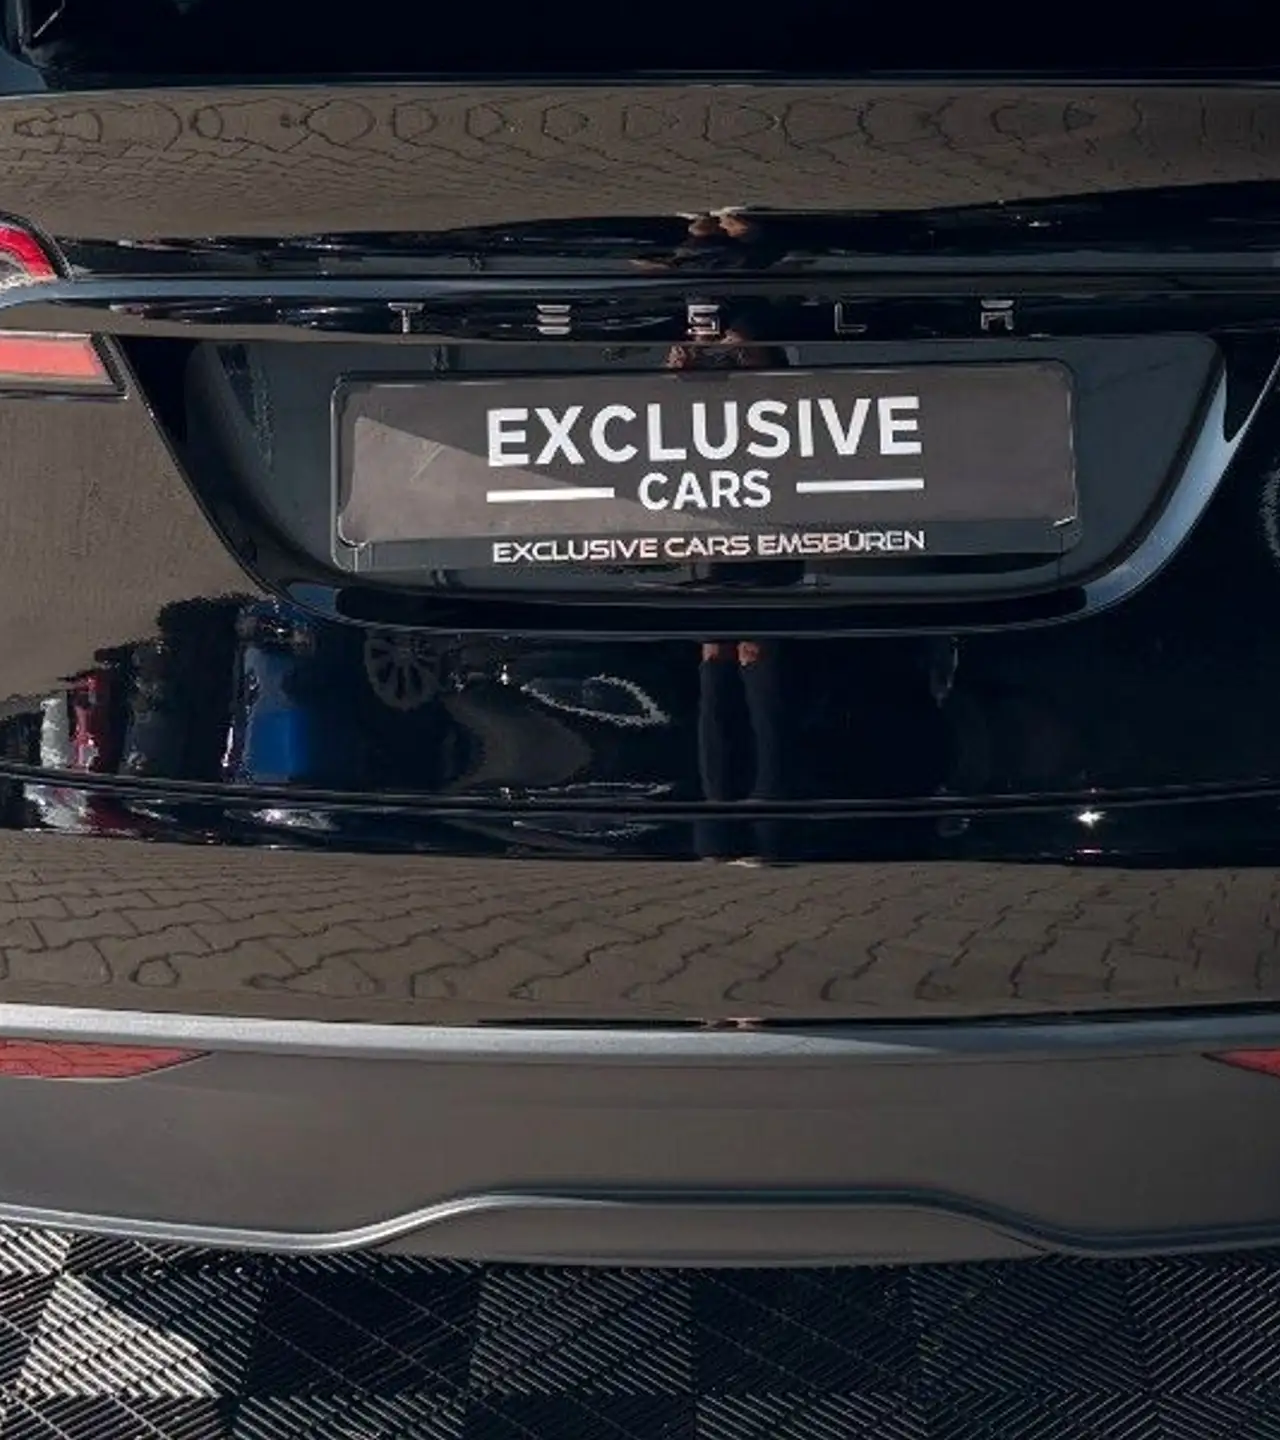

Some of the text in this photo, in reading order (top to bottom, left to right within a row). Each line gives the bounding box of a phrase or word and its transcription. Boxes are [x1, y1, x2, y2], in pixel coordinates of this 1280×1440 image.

[387, 300, 1015, 334] TESLA
[486, 396, 923, 467] EXCLUSIVE
[638, 470, 772, 511] CARS
[492, 529, 925, 564] EXCLUSIVE CARS EMSBÜREN
